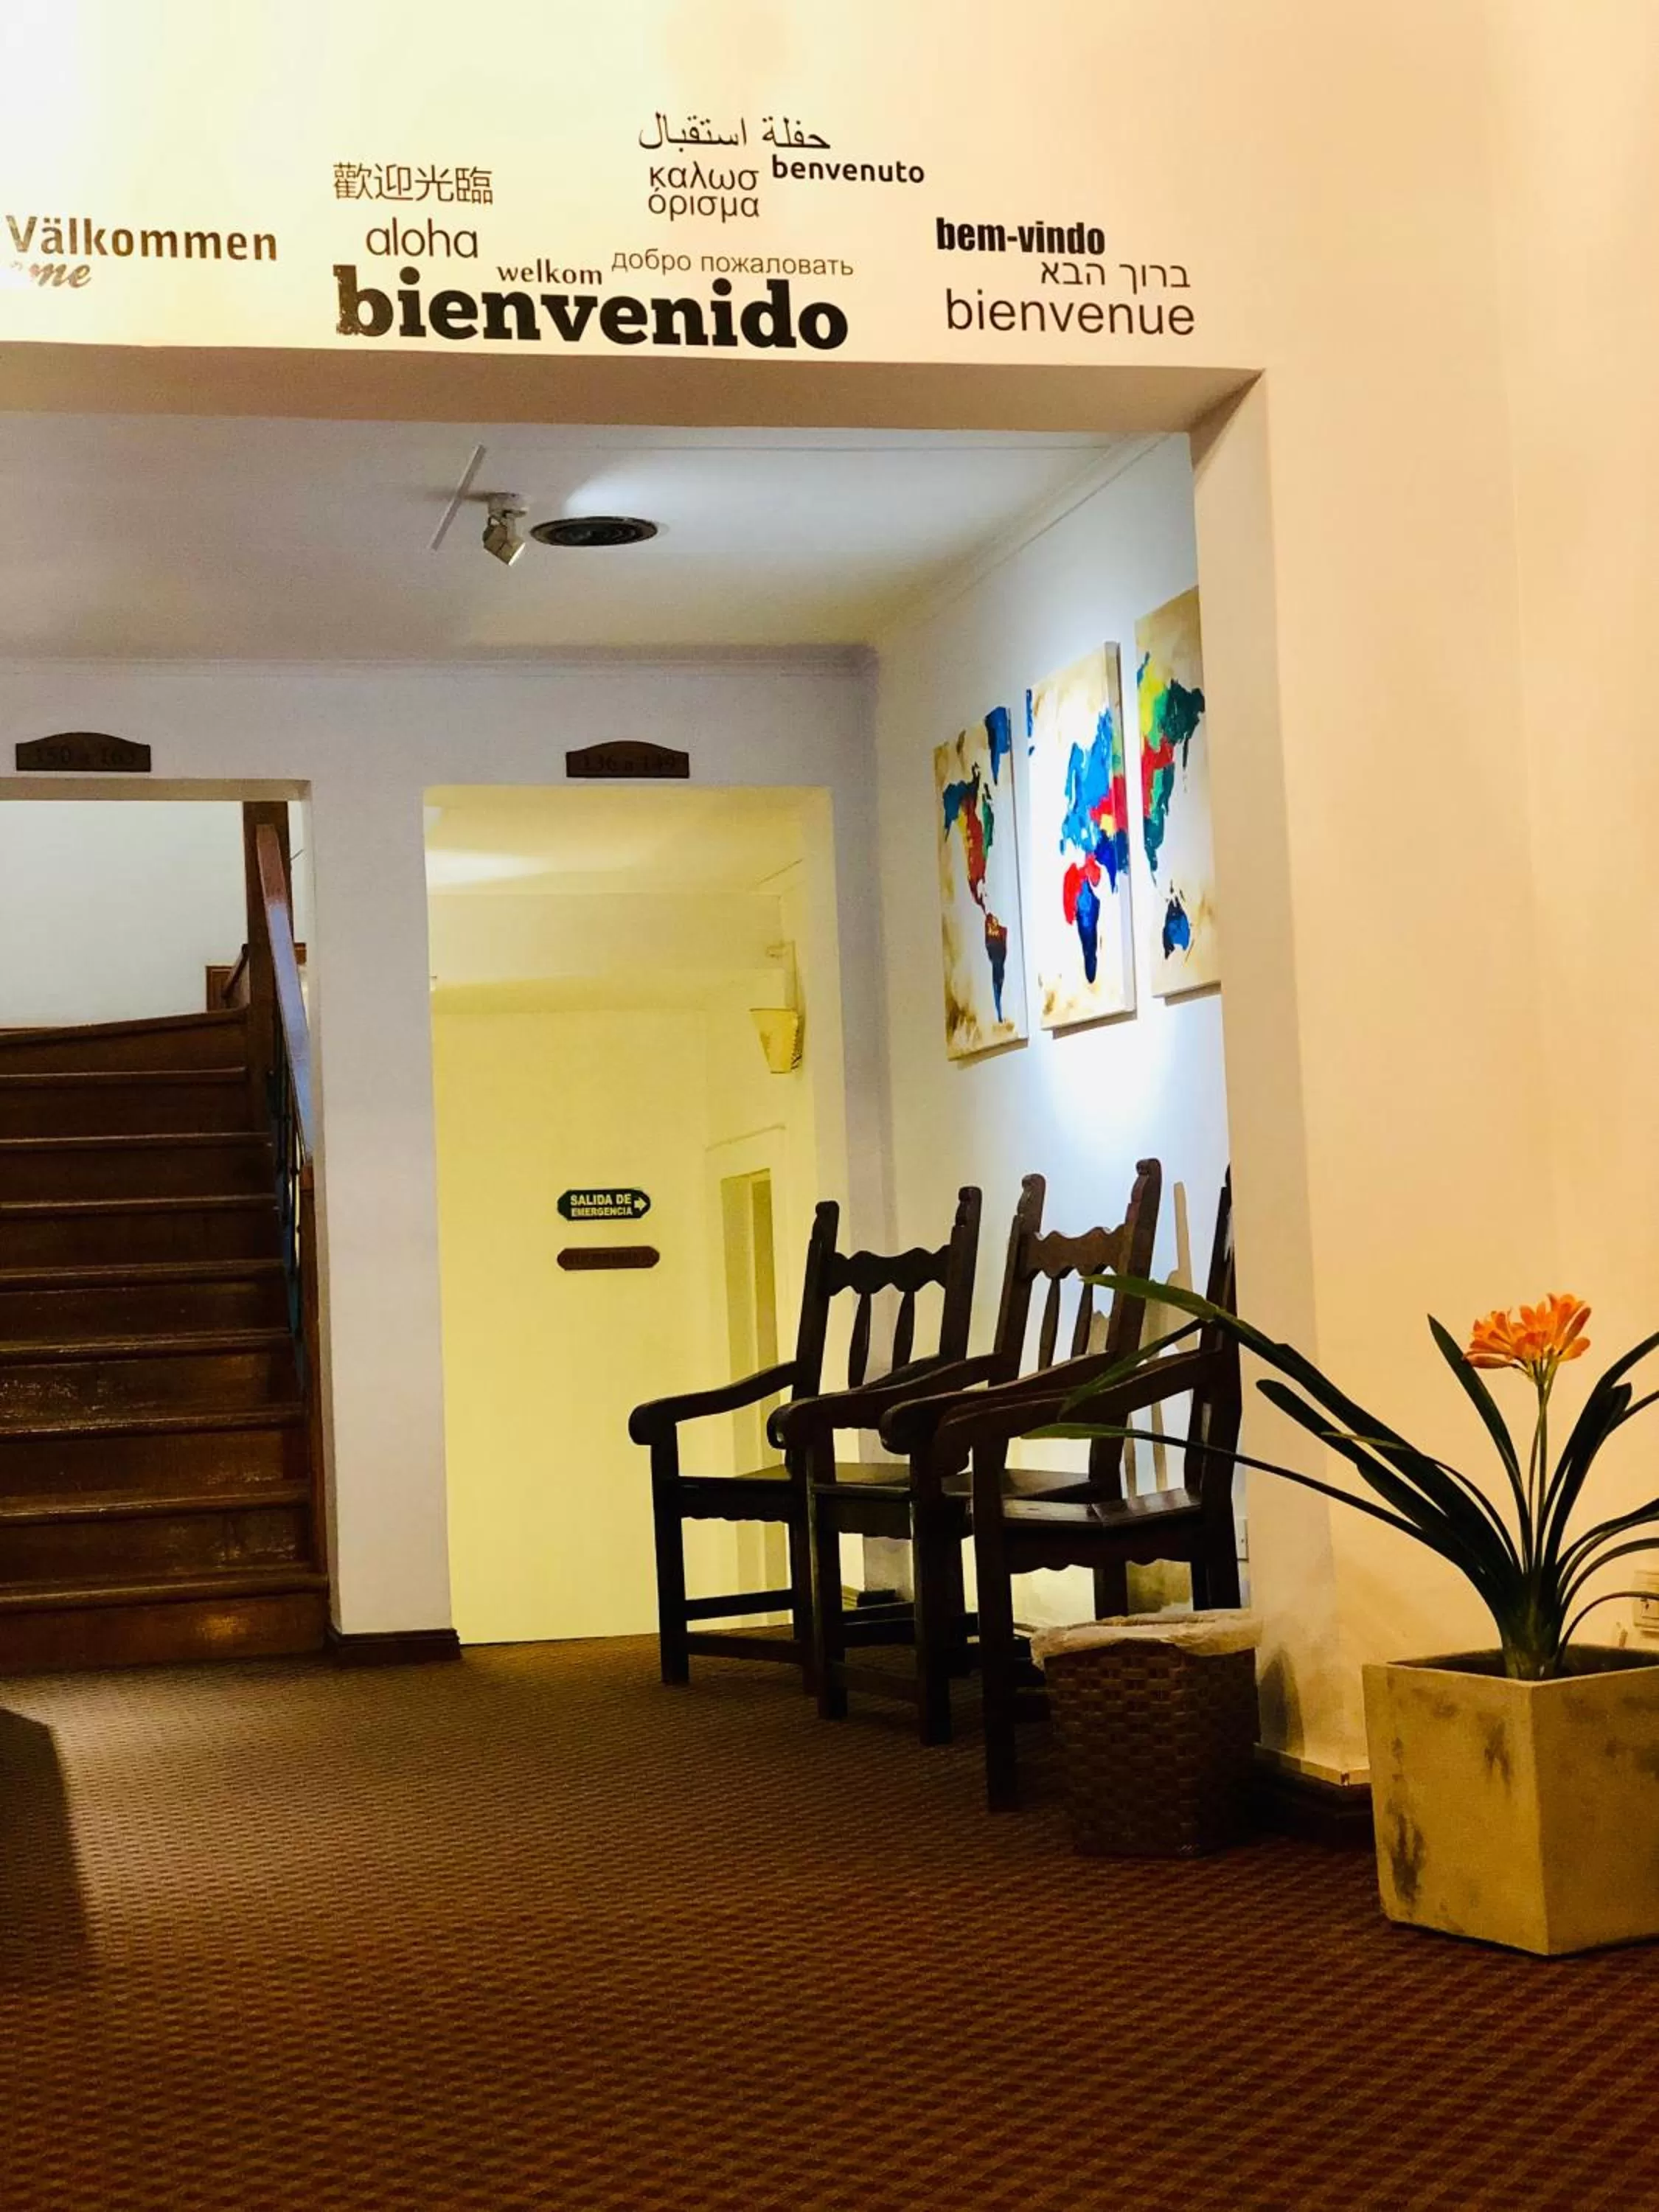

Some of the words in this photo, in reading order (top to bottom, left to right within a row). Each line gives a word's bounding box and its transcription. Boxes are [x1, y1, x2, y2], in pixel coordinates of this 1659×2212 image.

[639, 111, 747, 153] استقبال
[762, 116, 831, 150] حفلة
[333, 162, 493, 205] 歡迎光臨
[772, 153, 925, 184] benvenuto
[6, 215, 277, 261] Välkommen
[366, 217, 479, 258] aloha
[936, 217, 1106, 255] bem-vindo
[497, 258, 602, 285] welkom
[611, 248, 692, 275] добро
[701, 254, 854, 276] пожаловать
[1041, 262, 1106, 285] הבא
[1119, 264, 1191, 295] ברוך
[333, 264, 849, 350] bienvenido
[946, 288, 1194, 335] bienvenue
[570, 1194, 613, 1206] SALIDA
[616, 1194, 633, 1204] DE
[571, 1206, 633, 1217] EMERGENCIA
